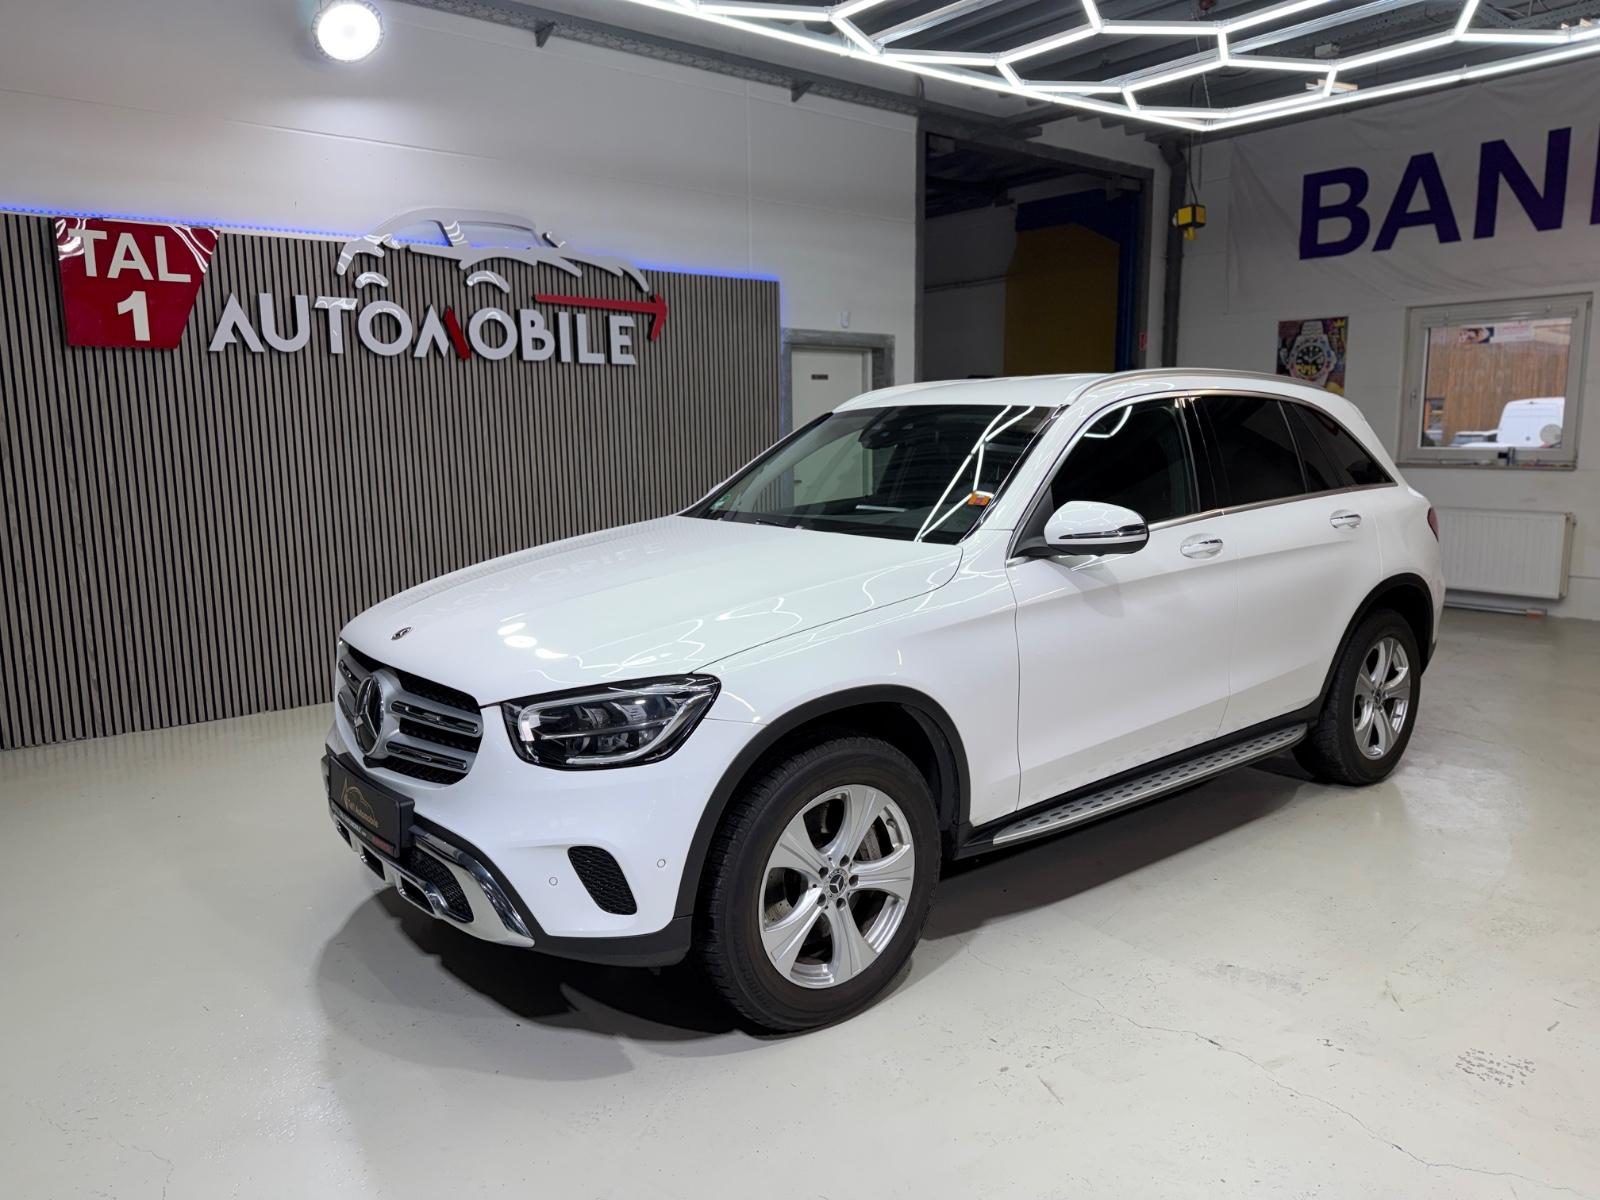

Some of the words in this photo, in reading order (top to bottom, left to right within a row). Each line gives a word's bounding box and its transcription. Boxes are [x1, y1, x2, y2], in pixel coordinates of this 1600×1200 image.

[1299, 121, 1600, 260] BAN
[68, 228, 191, 282] TAL
[117, 290, 150, 341] 1
[208, 292, 637, 365] AUTOMOBILE
